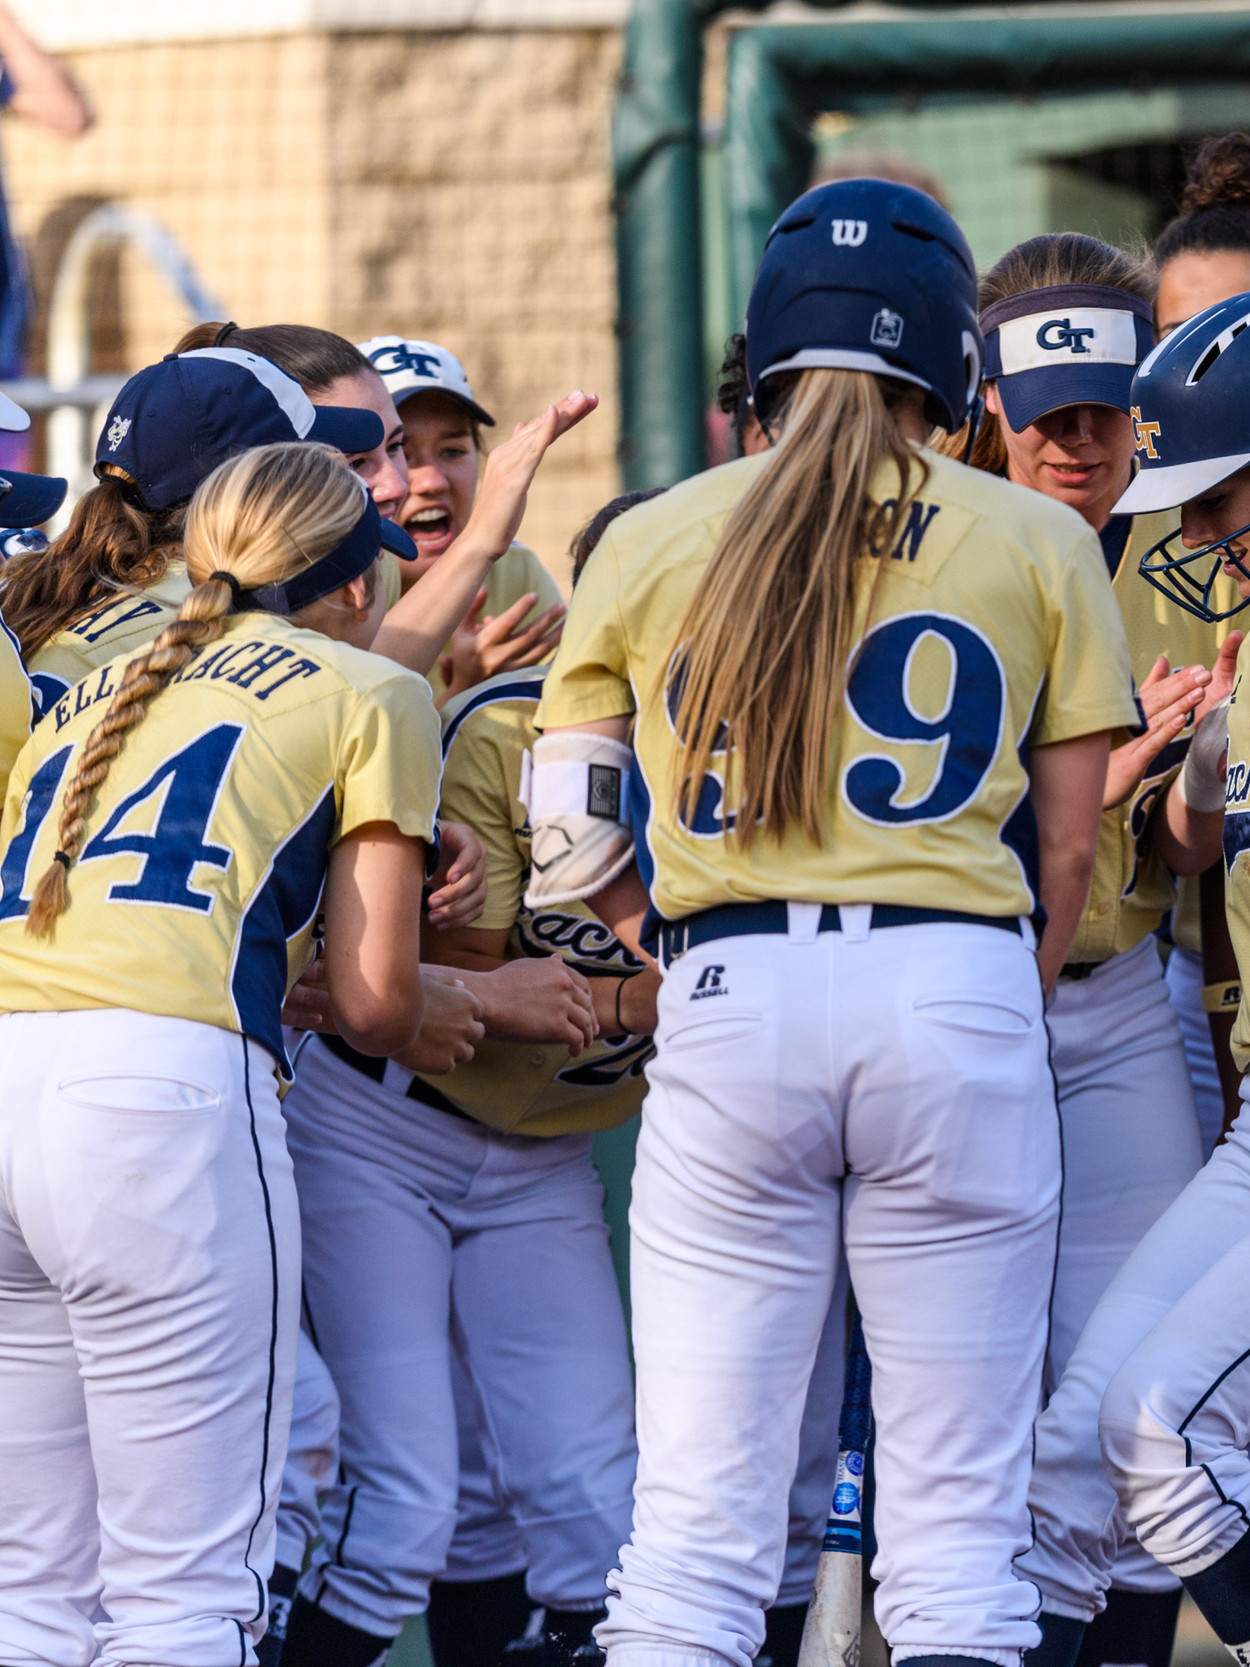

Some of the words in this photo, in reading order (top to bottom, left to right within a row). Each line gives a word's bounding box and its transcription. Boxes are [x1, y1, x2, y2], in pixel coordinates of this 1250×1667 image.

[1036, 318, 1094, 353] GT
[368, 344, 441, 379] GT
[0, 720, 248, 924] 14
